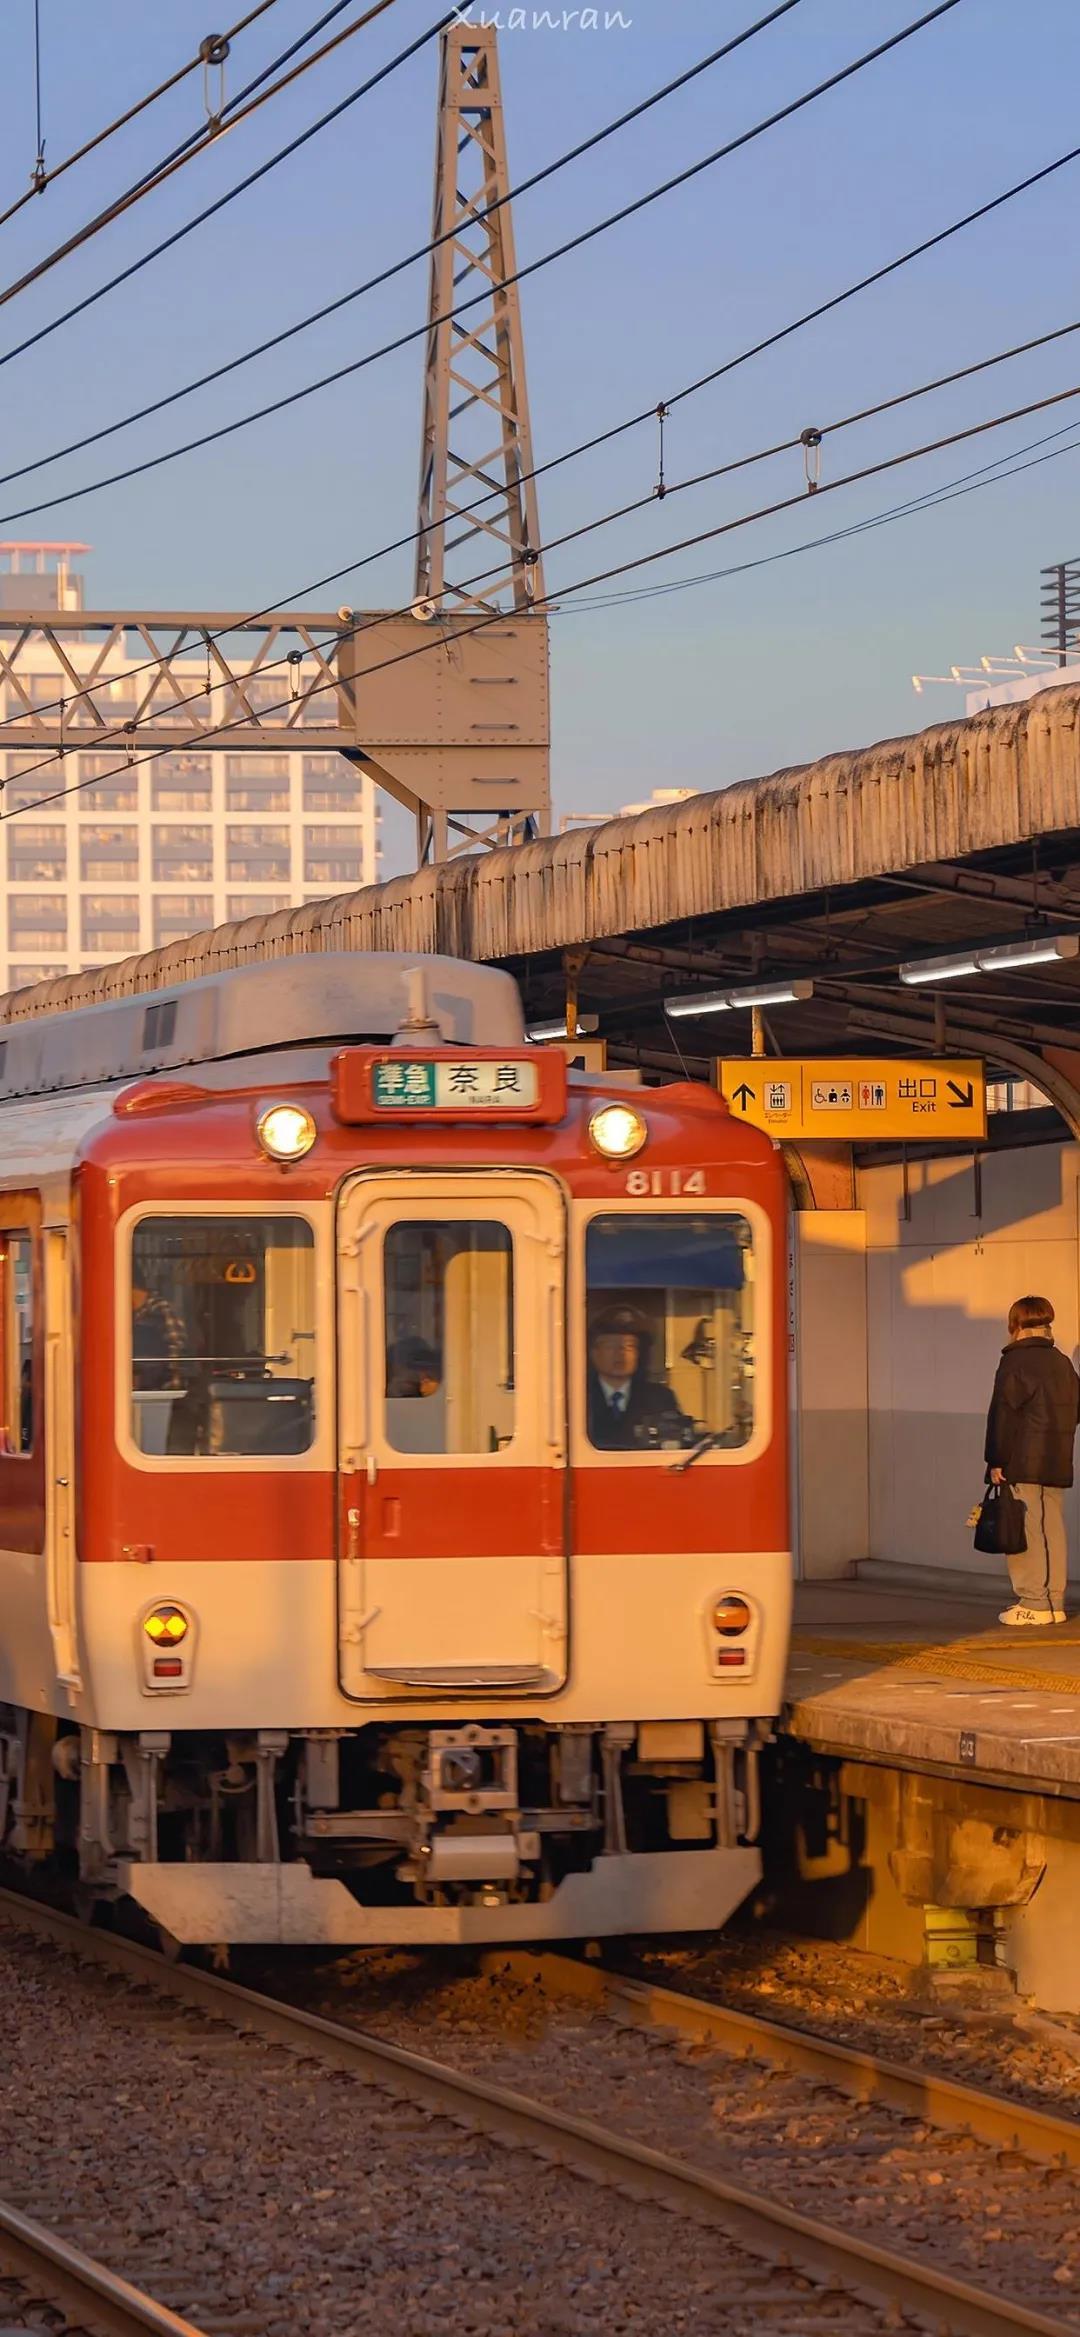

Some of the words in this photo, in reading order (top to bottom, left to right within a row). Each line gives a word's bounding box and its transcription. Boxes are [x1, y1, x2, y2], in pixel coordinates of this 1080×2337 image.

[377, 1064, 431, 1094] 準急
[448, 1065, 521, 1093] 奈良
[898, 1078, 936, 1098] 出口
[912, 1101, 937, 1113] Exit
[625, 1170, 706, 1195] 8114
[1015, 1610, 1036, 1621] Fila
